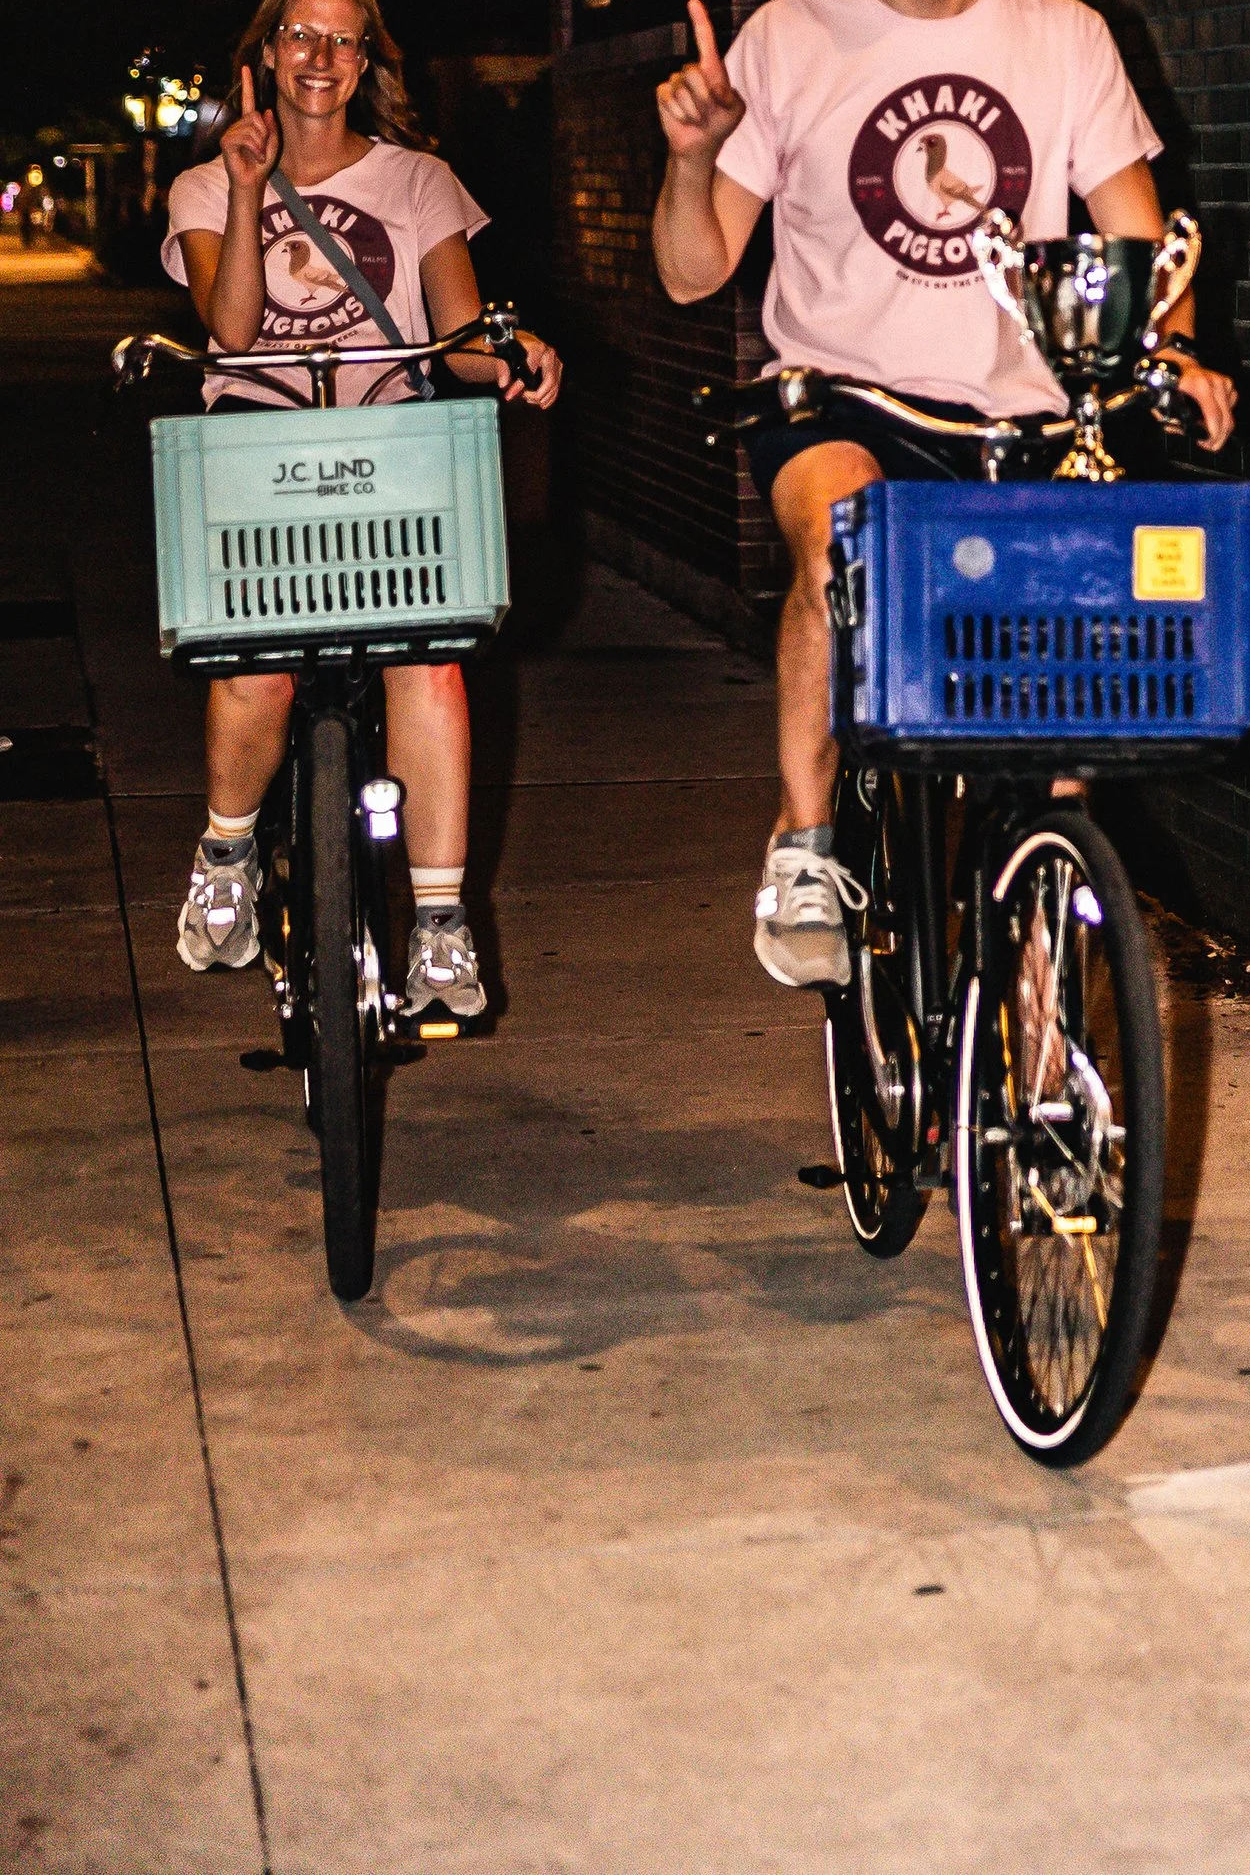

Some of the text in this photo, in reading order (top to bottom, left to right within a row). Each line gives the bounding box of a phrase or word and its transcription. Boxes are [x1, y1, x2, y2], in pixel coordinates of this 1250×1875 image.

[875, 84, 1001, 141] KHAKI
[262, 202, 358, 246] HKI
[883, 219, 978, 266] PIGEO
[362, 256, 388, 264] PALMS
[262, 296, 365, 336] IGEONS
[317, 483, 349, 496] BIKE
[319, 458, 375, 481] LIND
